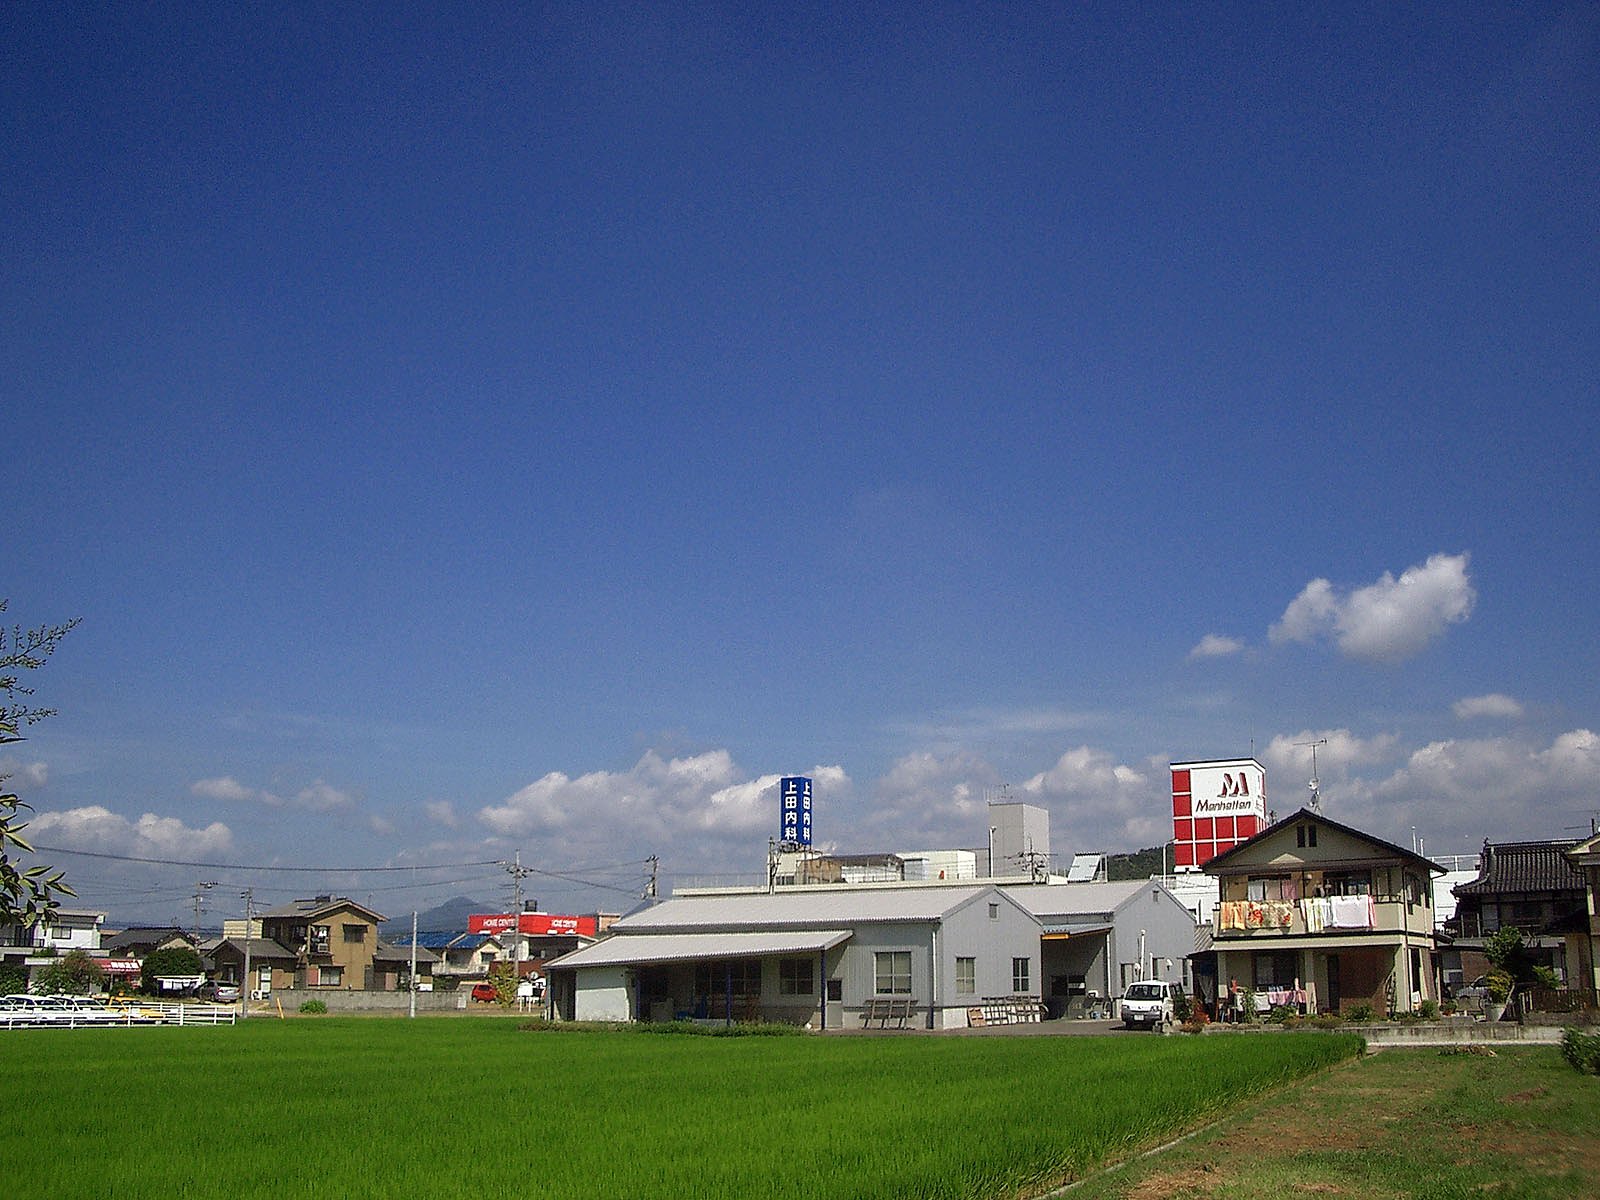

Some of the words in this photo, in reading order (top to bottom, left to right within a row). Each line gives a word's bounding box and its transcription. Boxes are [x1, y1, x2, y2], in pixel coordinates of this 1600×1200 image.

[785, 781, 797, 840] 上田内科
[1195, 799, 1251, 812] Manhattan
[483, 918, 497, 927] HOME
[498, 918, 517, 927] CENTE
